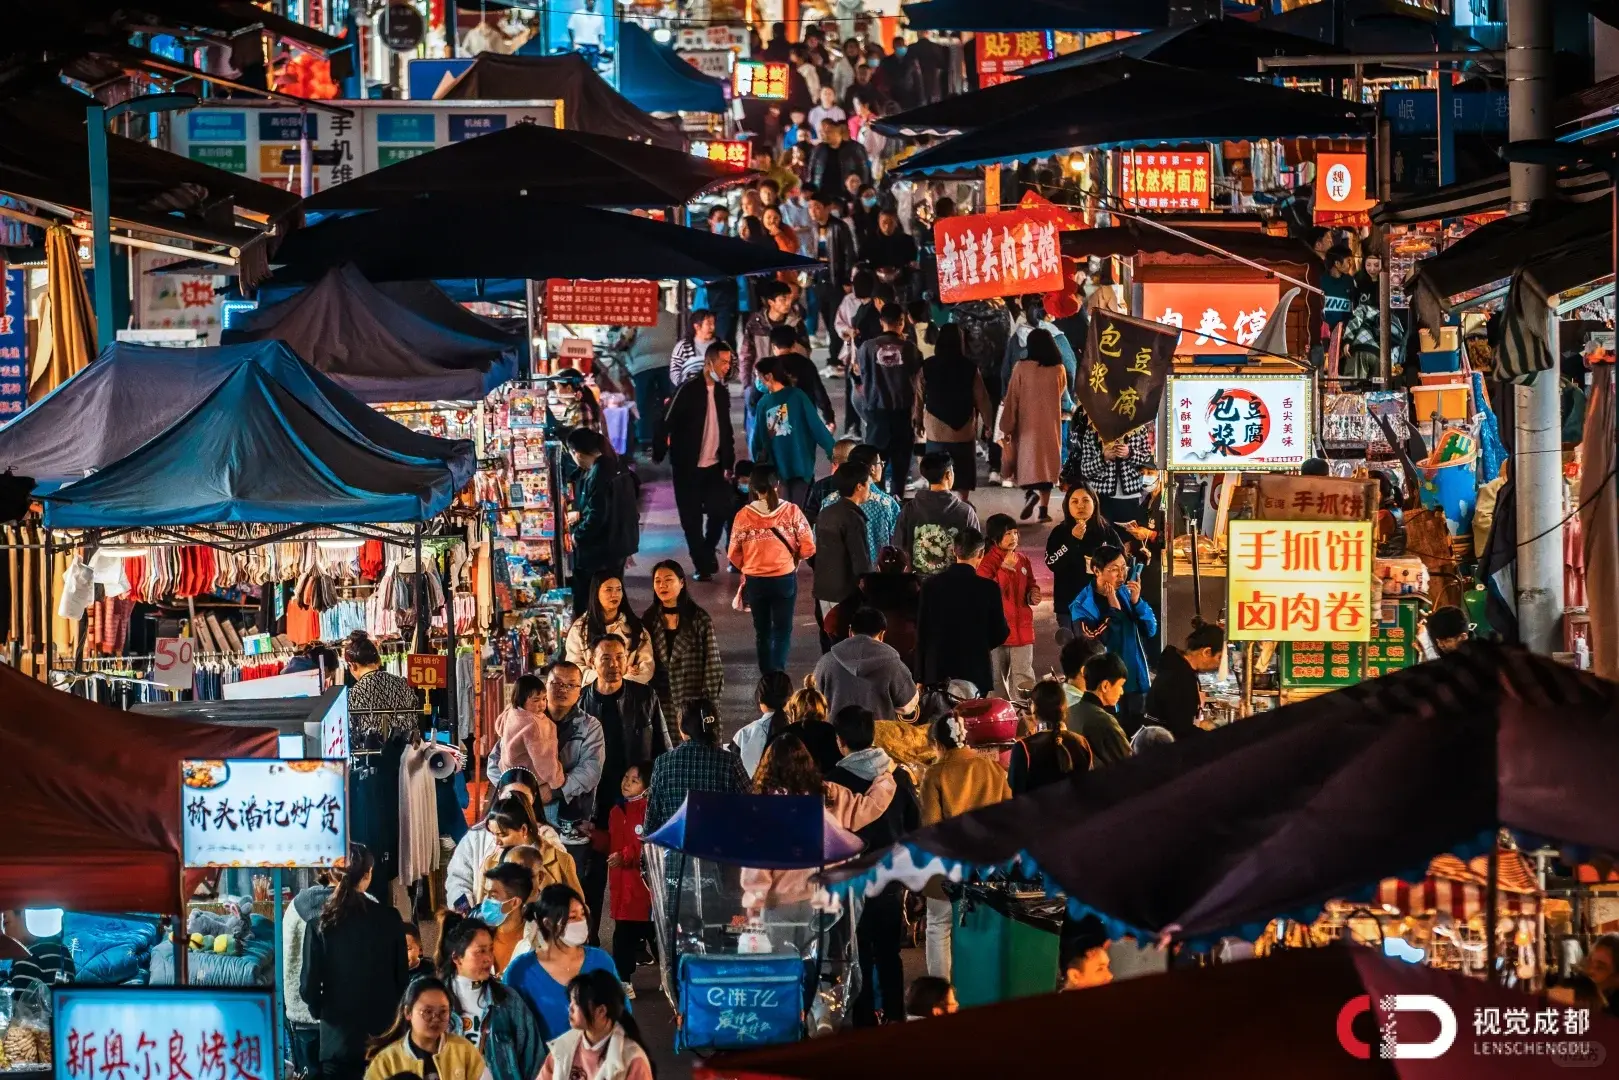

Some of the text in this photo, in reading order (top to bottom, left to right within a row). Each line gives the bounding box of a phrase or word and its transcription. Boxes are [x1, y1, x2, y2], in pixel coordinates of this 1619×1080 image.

[985, 31, 1043, 58] 贴膜
[1332, 170, 1345, 198] 魏氏
[1180, 397, 1193, 448] 外酥里嫩
[1281, 397, 1295, 447] 舌尖美味
[1291, 490, 1364, 518] 手抓饼
[1236, 530, 1366, 572] 手抓饼
[1238, 590, 1366, 632] 卤肉卷
[156, 638, 193, 671] 50
[413, 656, 441, 665] 促销价
[1292, 652, 1350, 665] 甜水面 8元
[1386, 646, 1405, 658] 8元
[1331, 666, 1350, 678] 8元
[187, 793, 342, 836] 桥头潘记炒货
[66, 1027, 262, 1080] 新奥尔良烤翅
